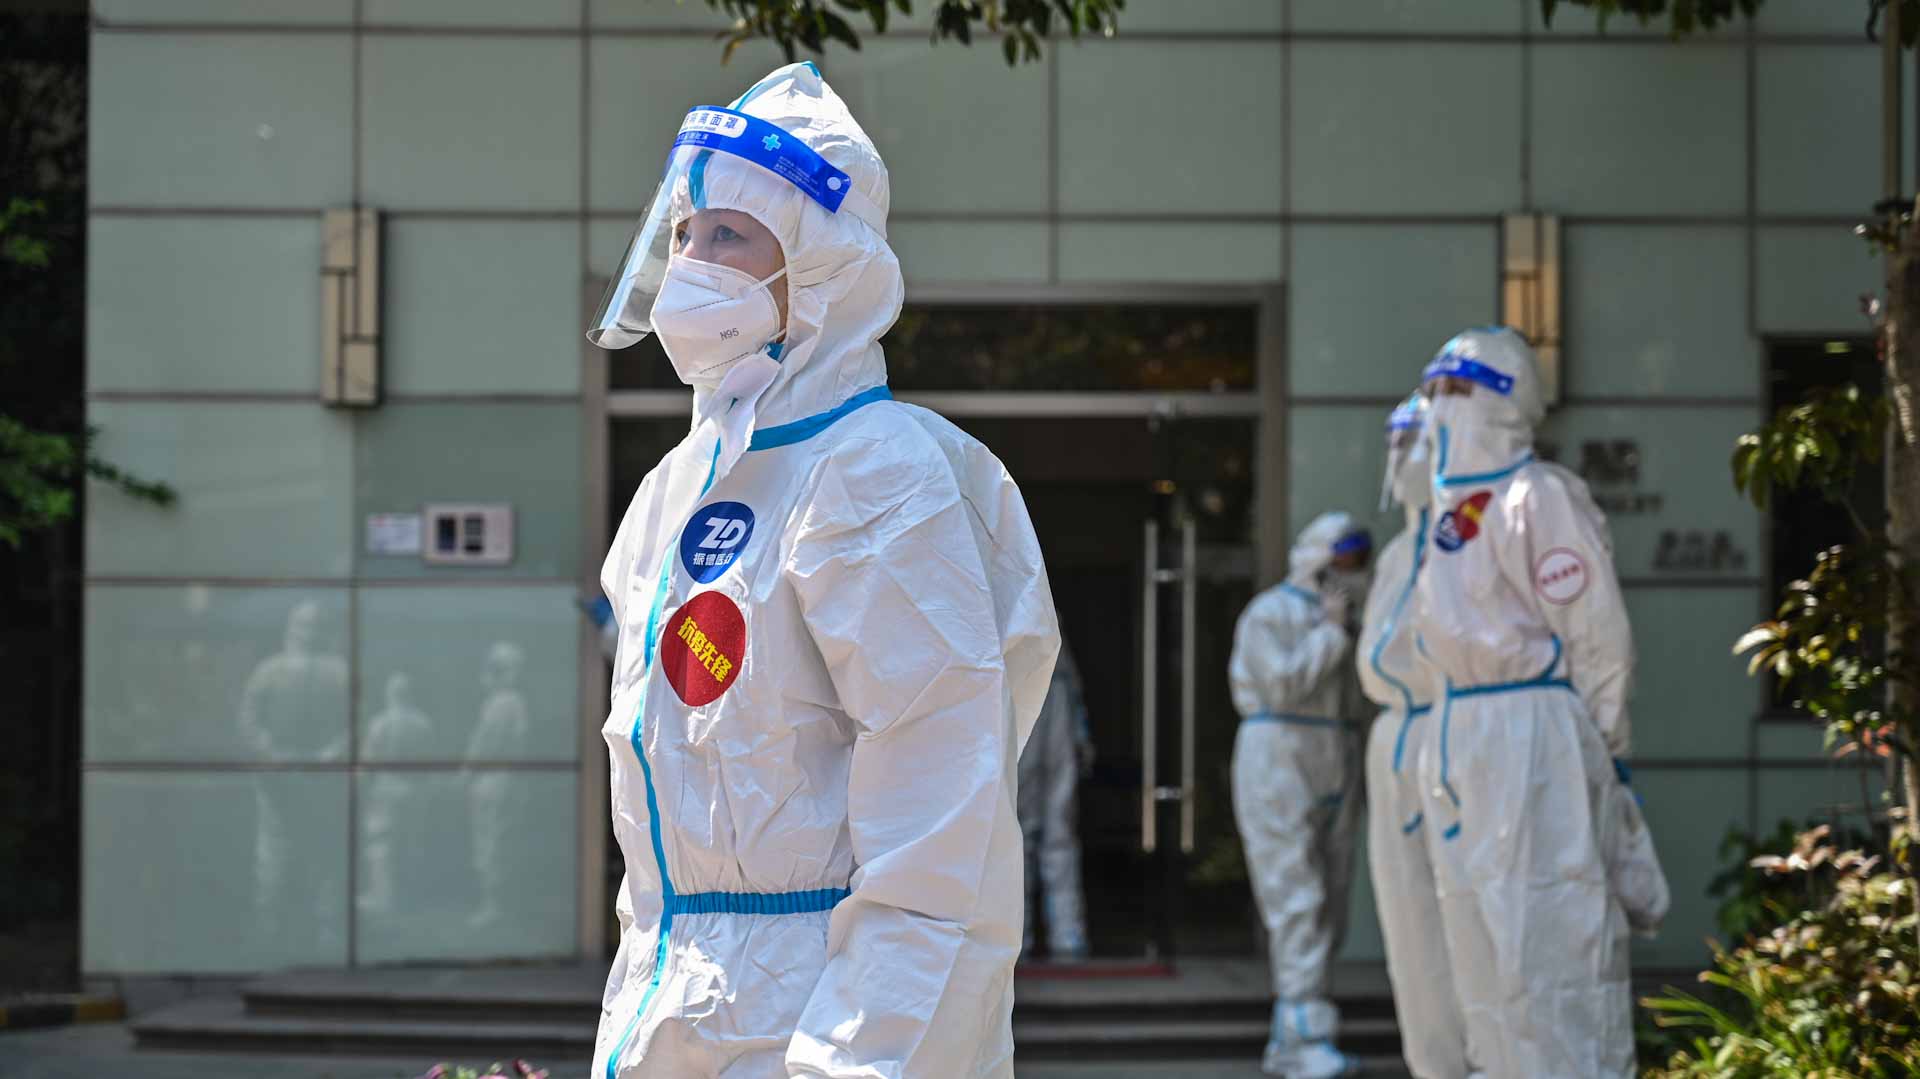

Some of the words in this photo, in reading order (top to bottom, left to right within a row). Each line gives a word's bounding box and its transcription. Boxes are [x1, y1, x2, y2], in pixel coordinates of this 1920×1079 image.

[720, 328, 739, 341] N95
[698, 517, 746, 549] ZD
[677, 616, 733, 682] 抗疫先锋
